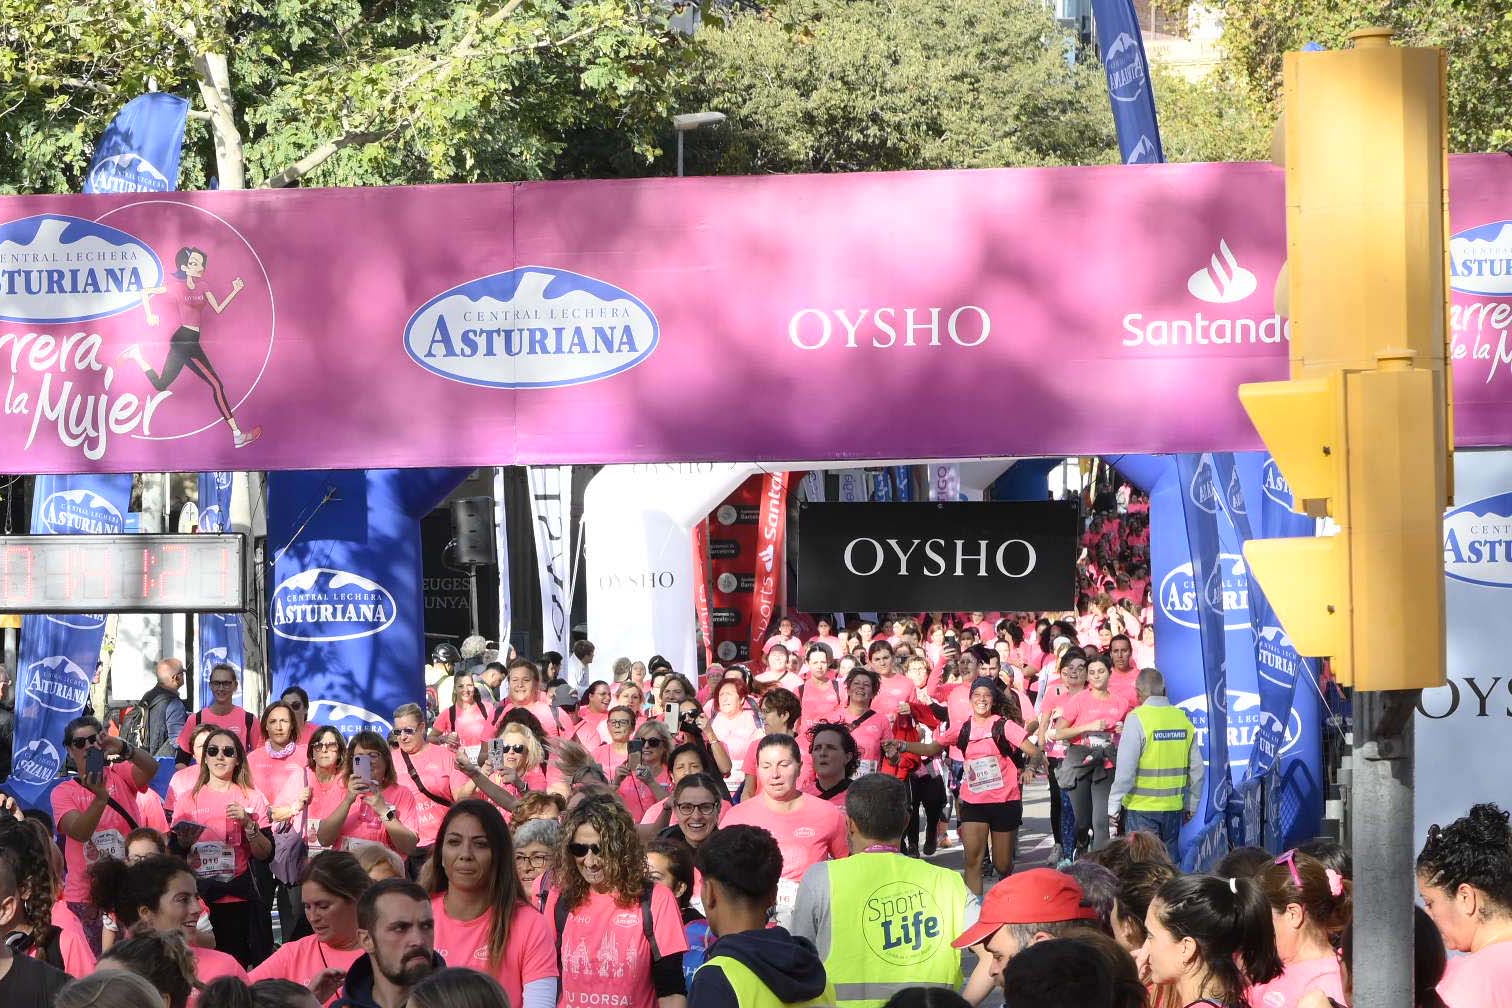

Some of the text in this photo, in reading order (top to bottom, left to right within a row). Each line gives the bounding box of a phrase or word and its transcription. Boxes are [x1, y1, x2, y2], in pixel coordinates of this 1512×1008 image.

[66, 250, 138, 262] LECHERA
[463, 307, 631, 322] CENTRAL LECHERA
[789, 305, 991, 350] OYSHO
[425, 314, 639, 358] ASTURIANA
[5, 376, 29, 414] la
[24, 368, 173, 460] Mujer
[843, 536, 1038, 578] OYSHO
[274, 598, 387, 625] ASTURIANA
[287, 593, 382, 602] CENTRAL LECHERA
[868, 889, 927, 922] Sport
[881, 911, 940, 951] Life
